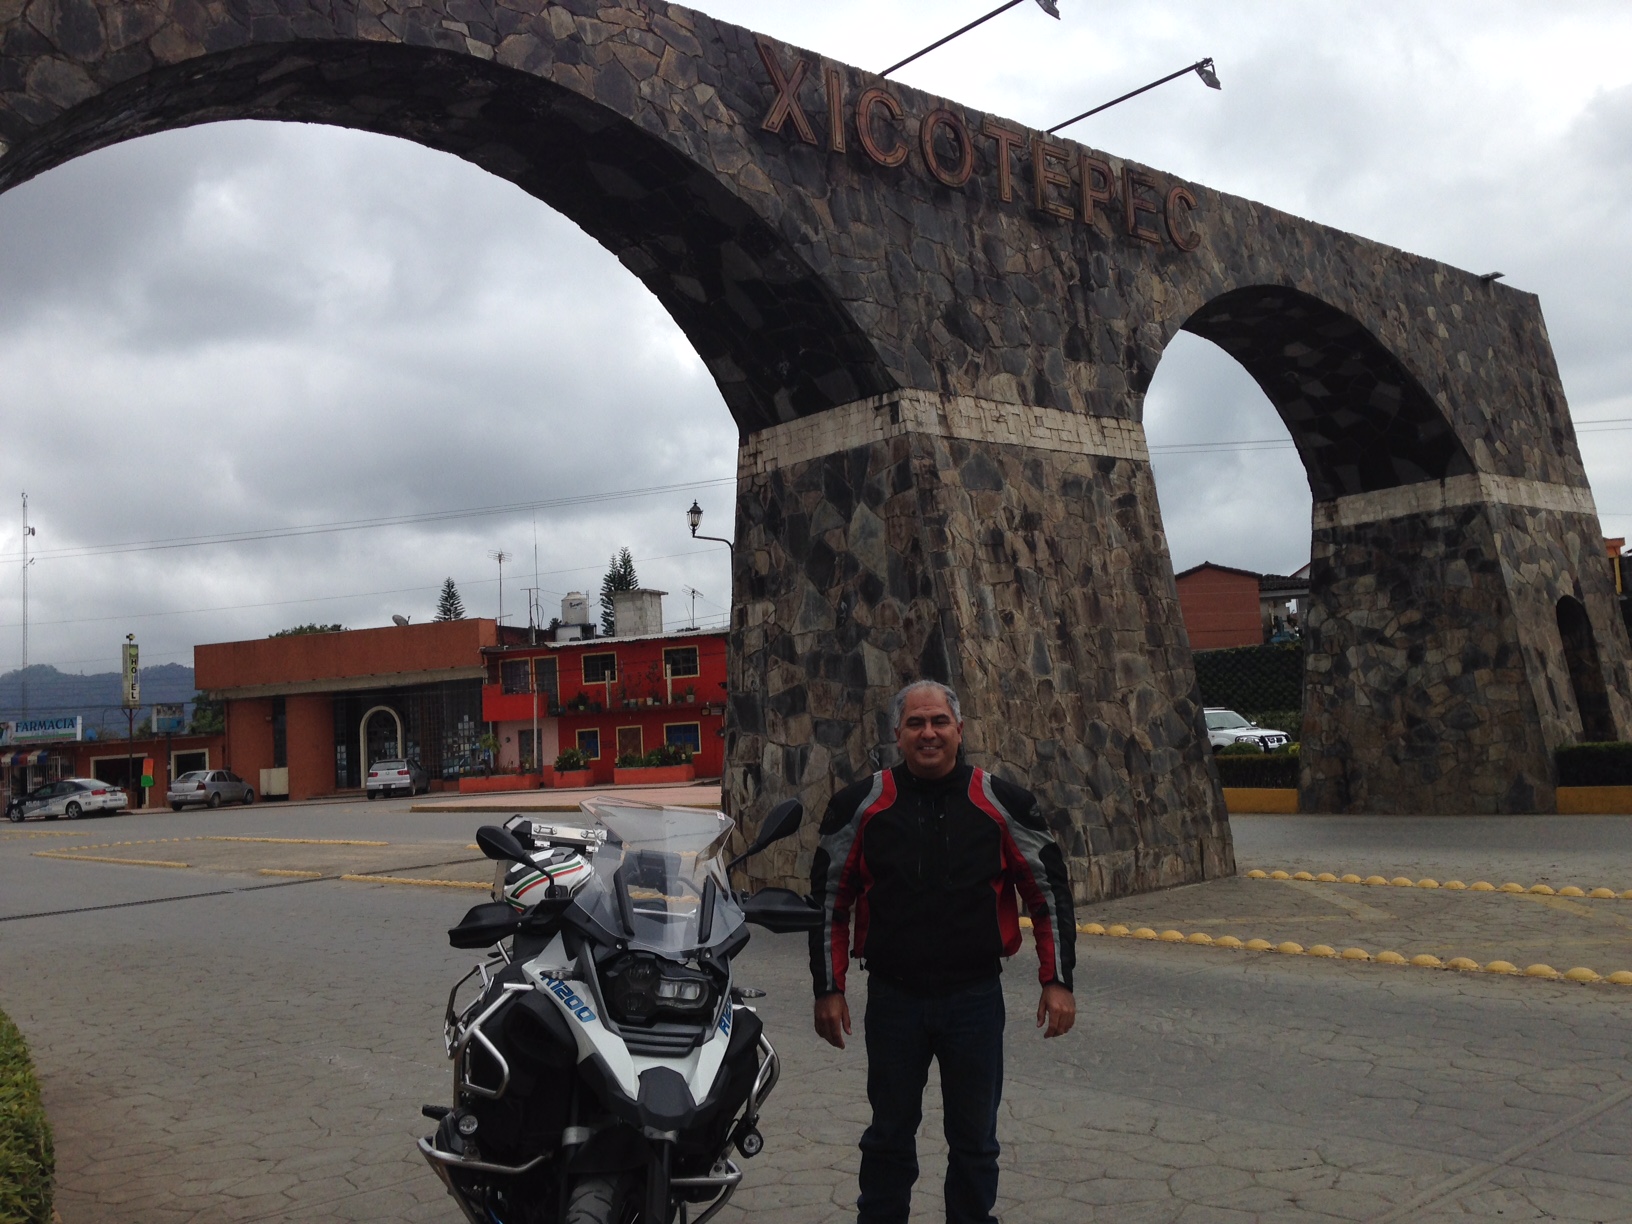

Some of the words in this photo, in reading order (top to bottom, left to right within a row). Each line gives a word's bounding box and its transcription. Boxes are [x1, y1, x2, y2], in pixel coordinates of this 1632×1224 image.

[754, 33, 1201, 252] XICOTEPEC
[130, 658, 138, 699] HOTEL
[15, 718, 75, 733] FARMACIA
